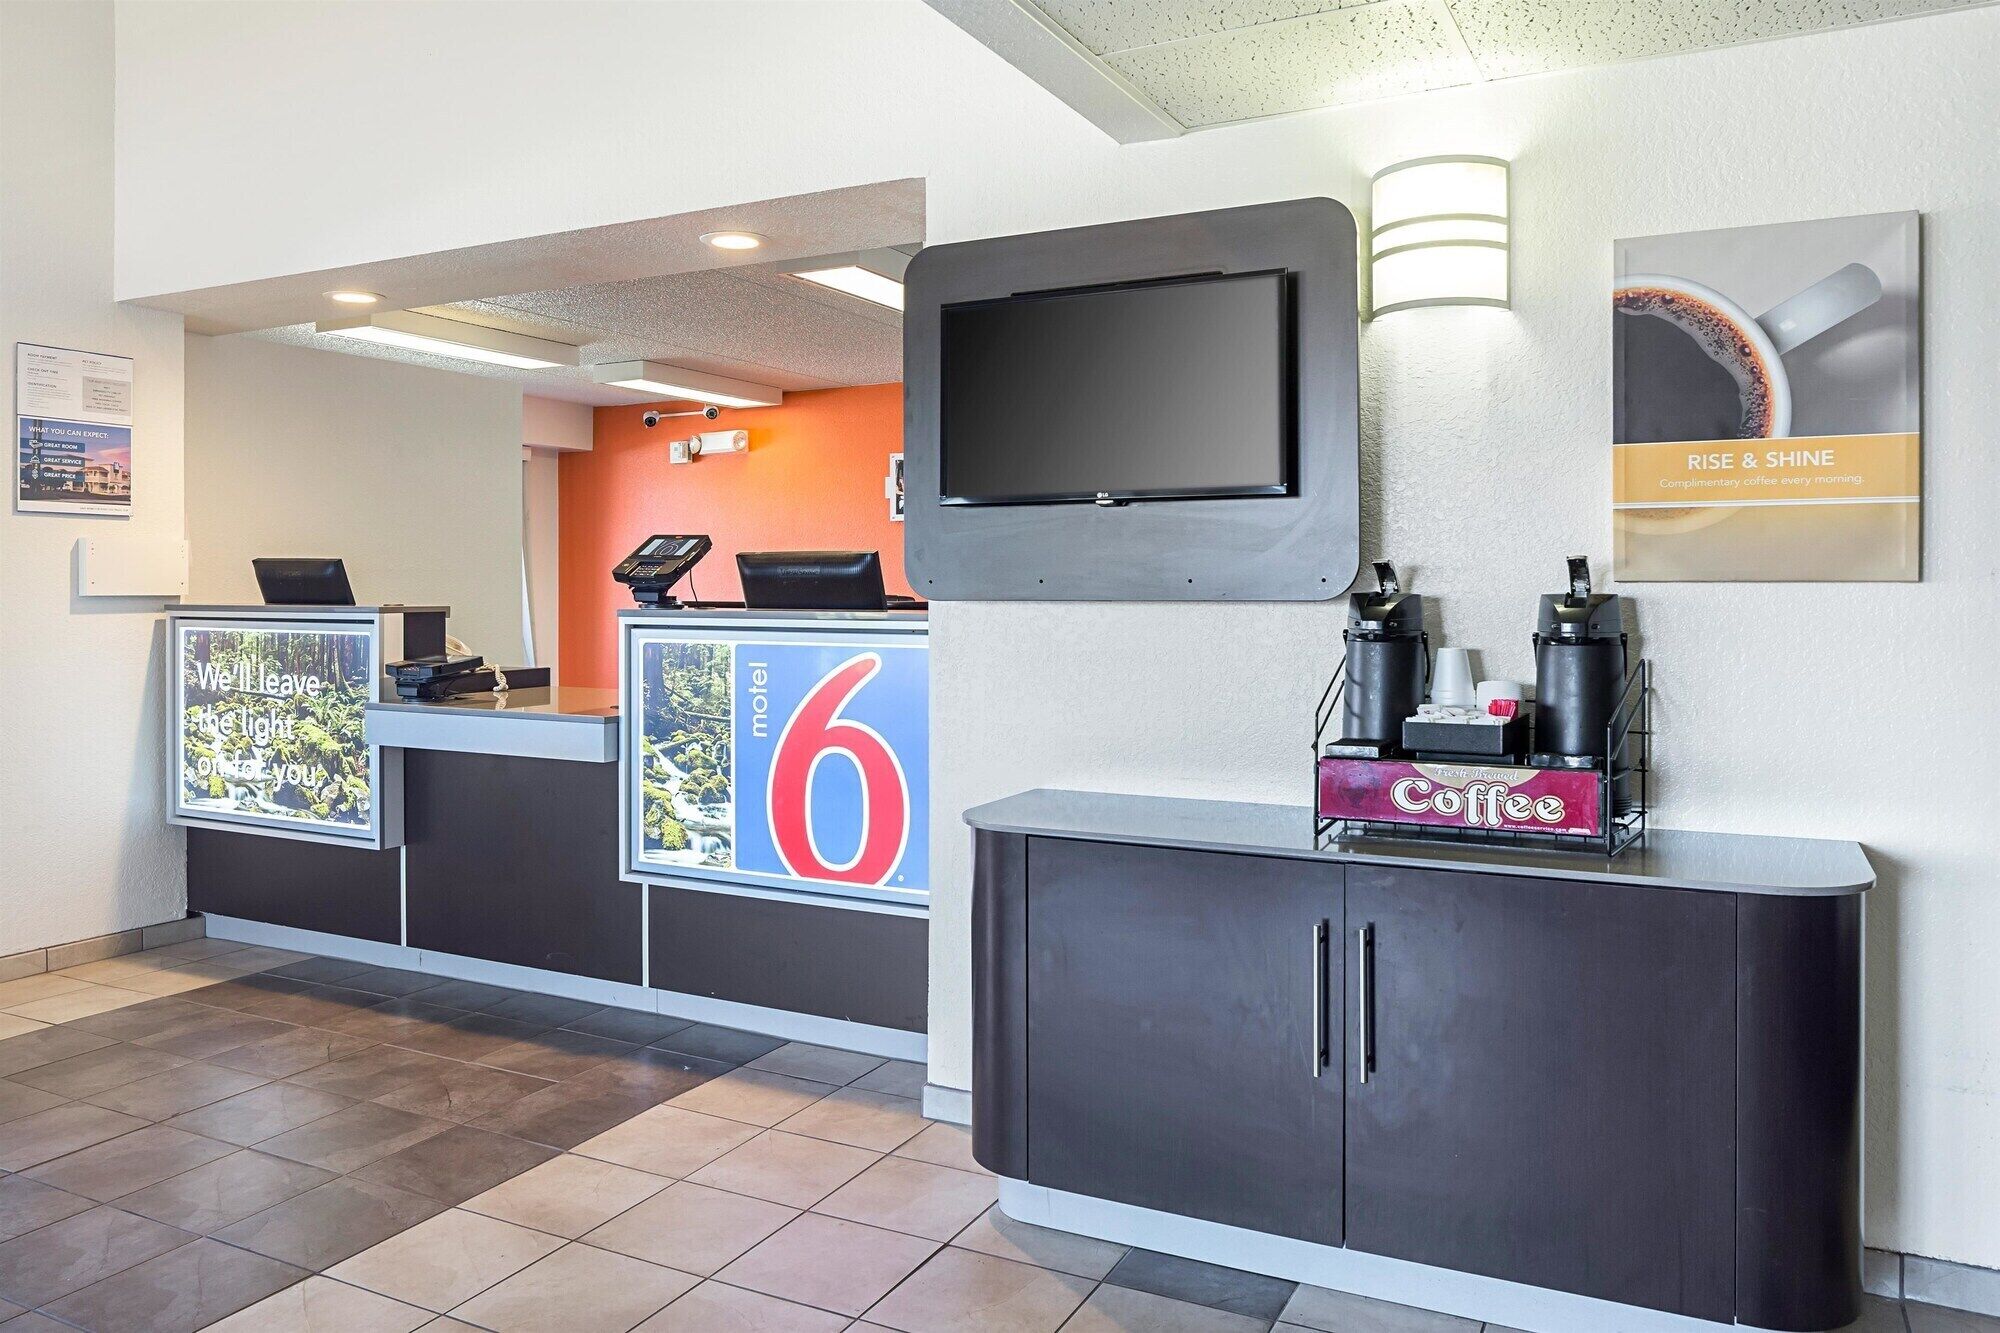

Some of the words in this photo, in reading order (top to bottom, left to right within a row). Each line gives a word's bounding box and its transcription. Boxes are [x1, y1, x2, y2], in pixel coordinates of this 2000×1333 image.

[28, 426, 49, 434] WHAT
[66, 429, 82, 437] CAN
[83, 431, 109, 439] EXPECT:
[1687, 452, 1734, 471] RISE
[1741, 452, 1758, 469] &
[1766, 450, 1835, 468] SHINE
[1659, 478, 1740, 491] Complimentary
[1743, 475, 1778, 487] coffee
[1781, 476, 1811, 487] every
[1814, 473, 1865, 485] morning.
[196, 660, 251, 692] We'll
[259, 663, 321, 697] leave
[199, 704, 234, 736] the
[242, 707, 296, 747] light
[197, 755, 226, 778] on
[231, 749, 266, 783] for
[748, 662, 768, 738] motel
[765, 651, 911, 887] 6
[1433, 767, 1467, 778] Fresh
[1470, 768, 1519, 781] Brewed
[1391, 777, 1565, 828] Coffee
